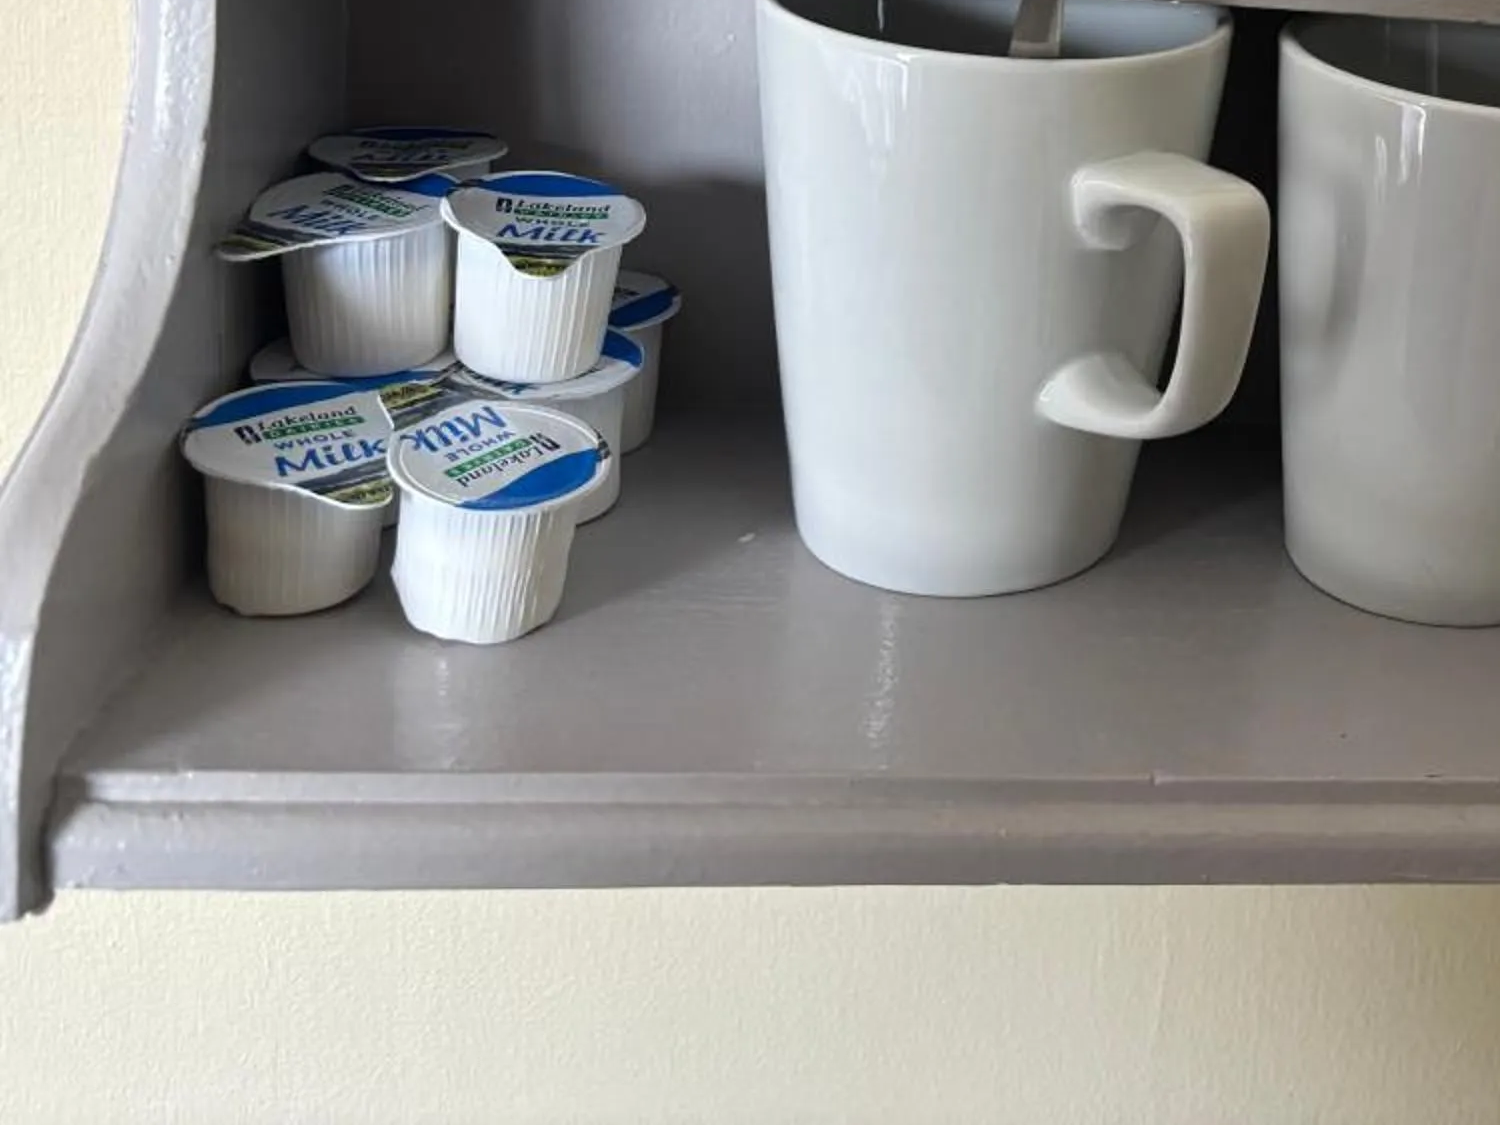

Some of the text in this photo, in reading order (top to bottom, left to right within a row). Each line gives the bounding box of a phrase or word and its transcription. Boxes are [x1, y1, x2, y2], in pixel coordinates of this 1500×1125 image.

[496, 223, 608, 243] Milk
[259, 406, 357, 431] Lakeland
[400, 405, 507, 452] Milk
[274, 429, 355, 450] WHOLE
[445, 430, 516, 462] WHOLE
[275, 438, 387, 477] Milk
[456, 440, 544, 487] Lakeland
